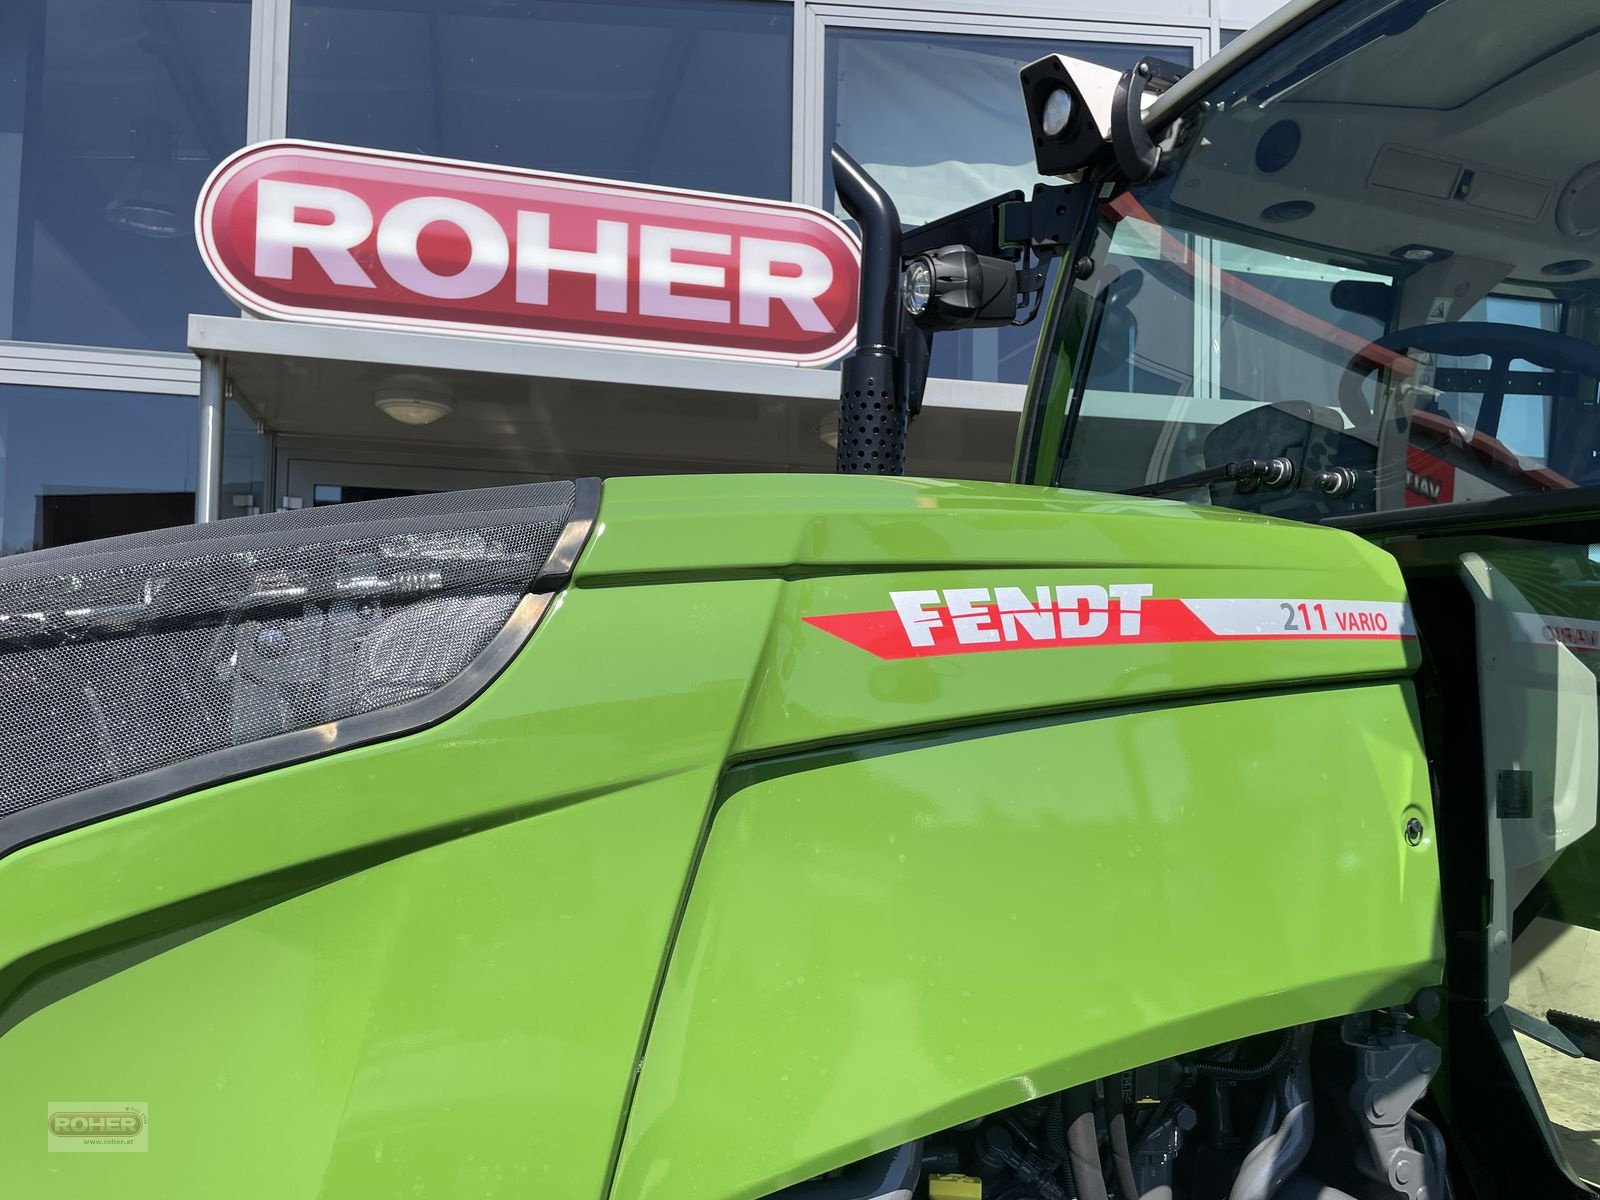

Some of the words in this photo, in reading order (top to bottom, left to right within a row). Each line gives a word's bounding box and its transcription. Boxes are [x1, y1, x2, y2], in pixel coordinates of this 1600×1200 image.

[254, 178, 836, 334] ROHER
[889, 583, 1153, 647] FENDT
[1280, 603, 1327, 630] 211
[1335, 612, 1388, 631] VARIO
